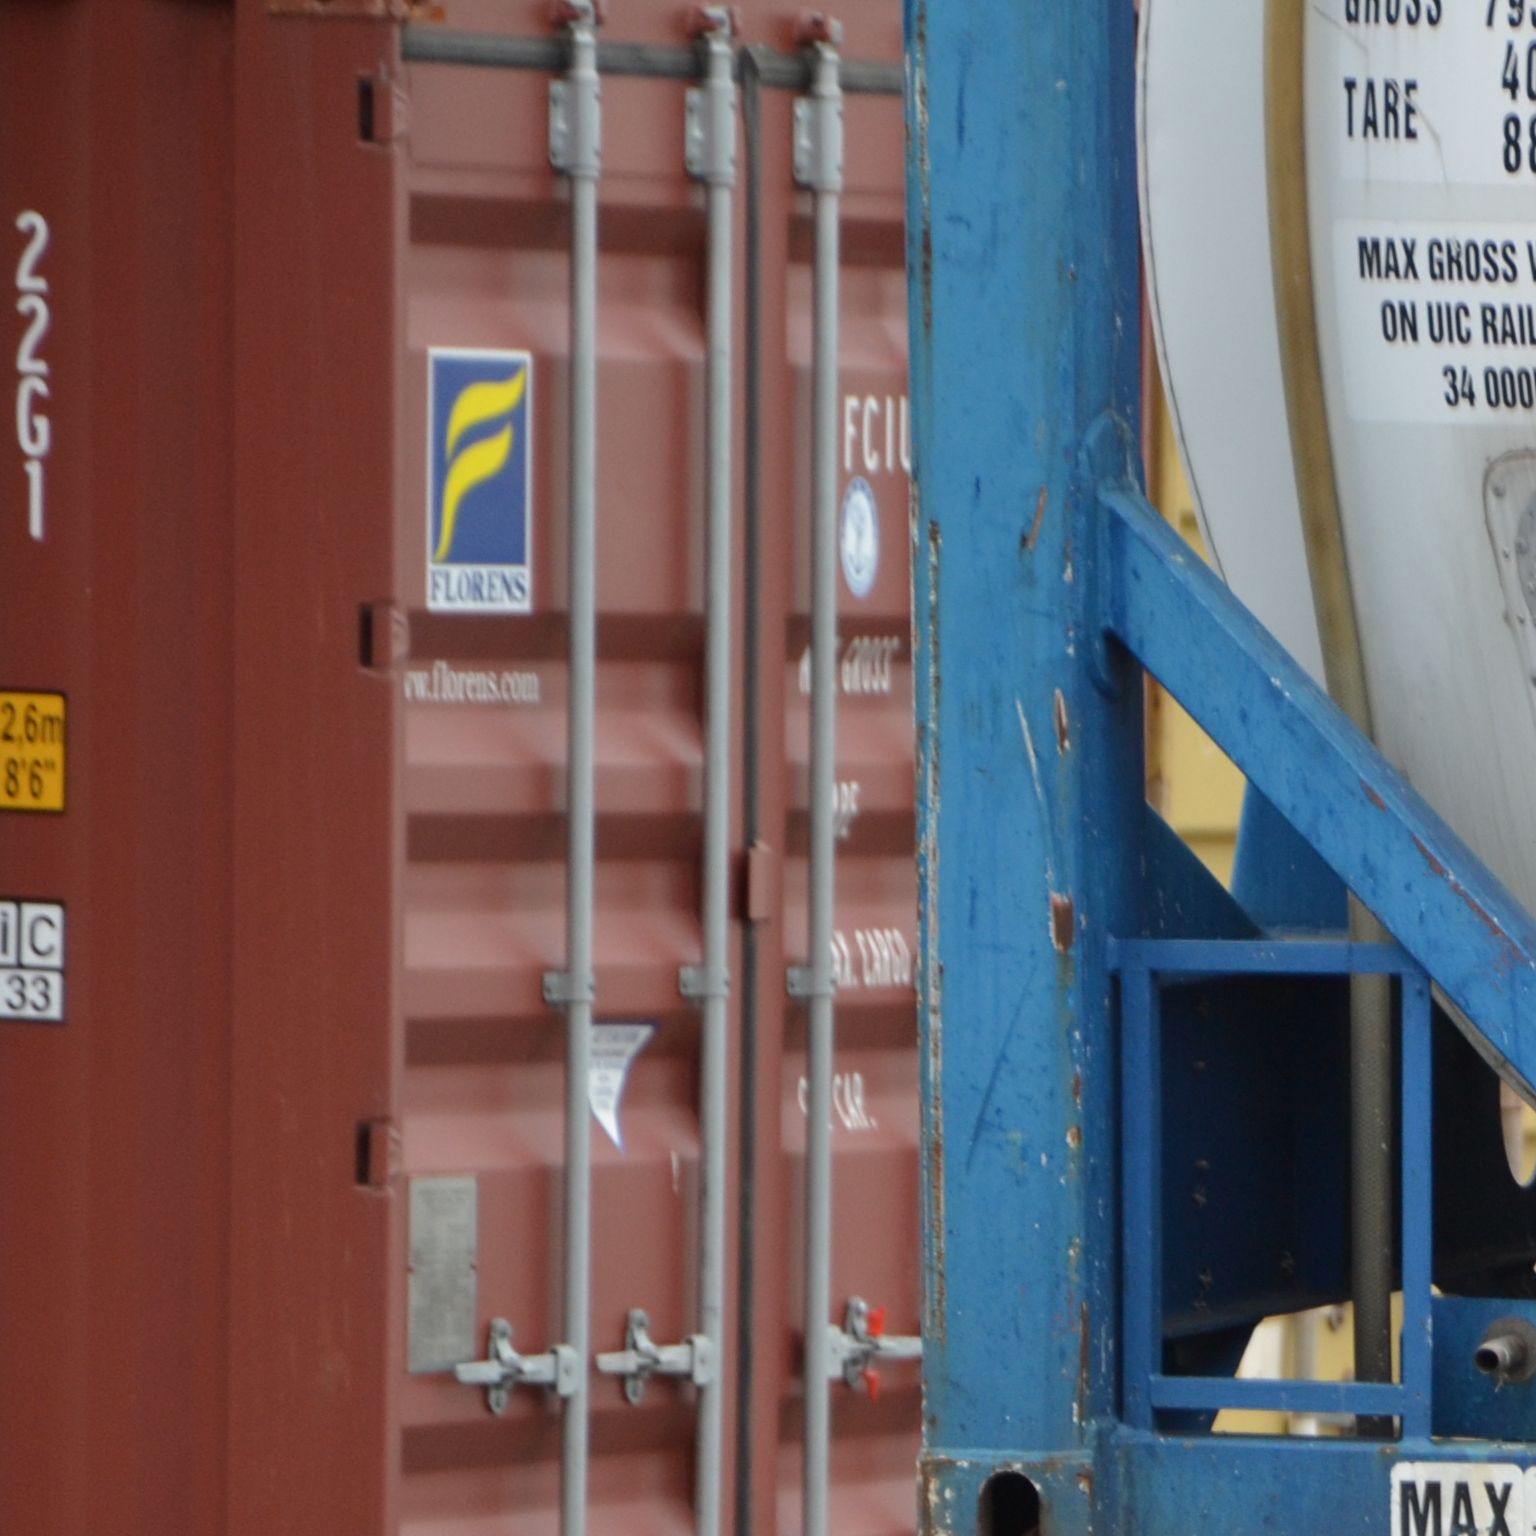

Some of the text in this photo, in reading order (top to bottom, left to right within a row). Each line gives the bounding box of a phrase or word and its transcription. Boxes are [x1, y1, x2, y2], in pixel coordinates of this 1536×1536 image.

[1344, 77, 1418, 138] TARE
[1357, 237, 1419, 280] MAX
[1429, 238, 1518, 284] GROSS
[1381, 300, 1418, 343] ON
[1428, 301, 1471, 345] UIC
[16, 209, 50, 541] 22G1
[1443, 365, 1476, 408] 34
[431, 568, 527, 603] FLORENS
[6, 973, 51, 1012] 33
